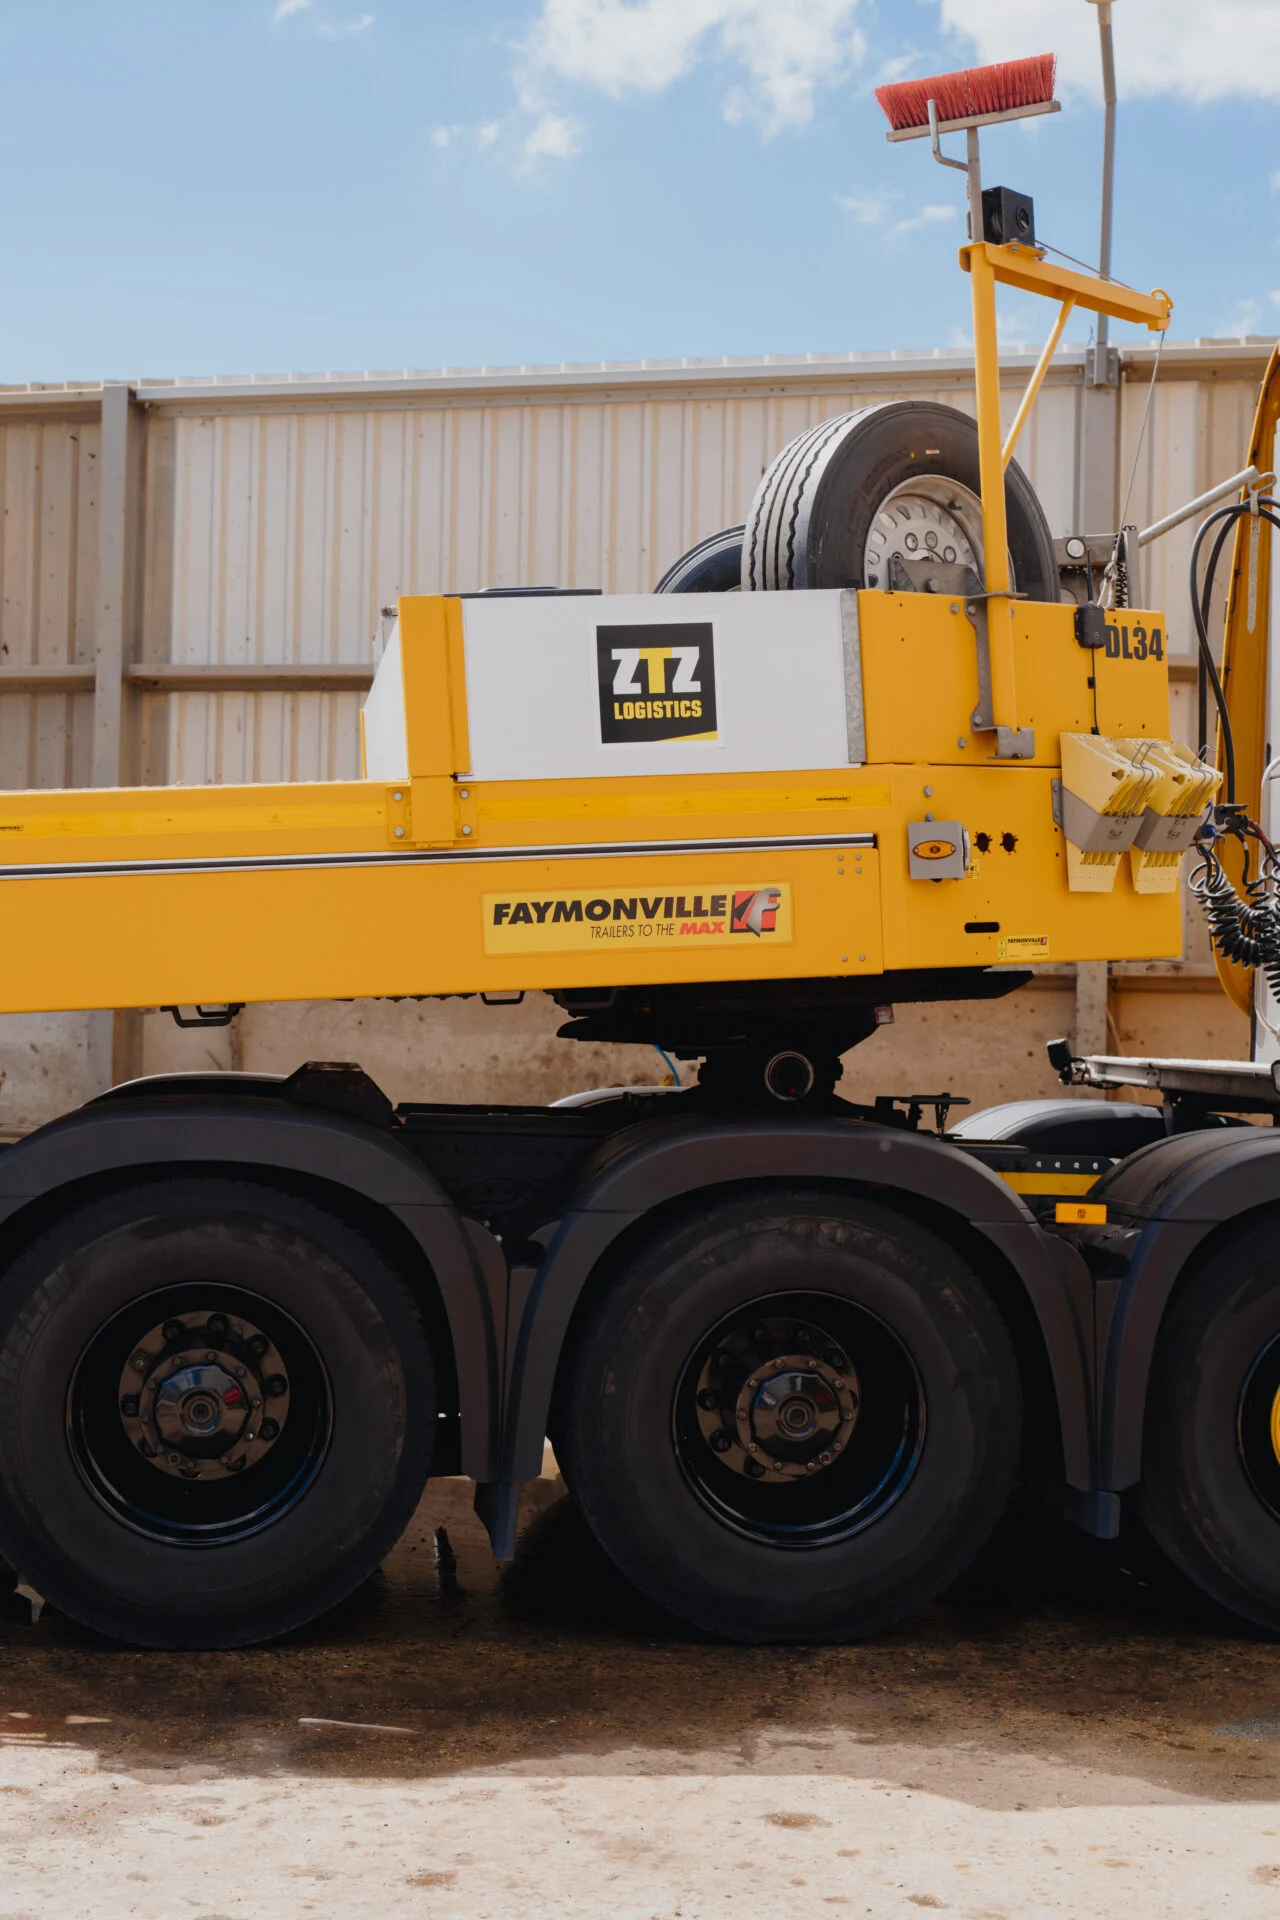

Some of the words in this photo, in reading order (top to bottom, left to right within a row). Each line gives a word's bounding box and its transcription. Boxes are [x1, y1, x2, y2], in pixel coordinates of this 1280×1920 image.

[1104, 625, 1164, 661] DL34
[611, 646, 702, 695] ZTZ
[613, 700, 703, 720] LOGISTICS
[493, 895, 727, 925] FAYMONVILLE
[590, 924, 634, 939] TRAILERS
[638, 923, 653, 937] TO
[656, 923, 675, 936] THE
[679, 921, 725, 935] MAX
